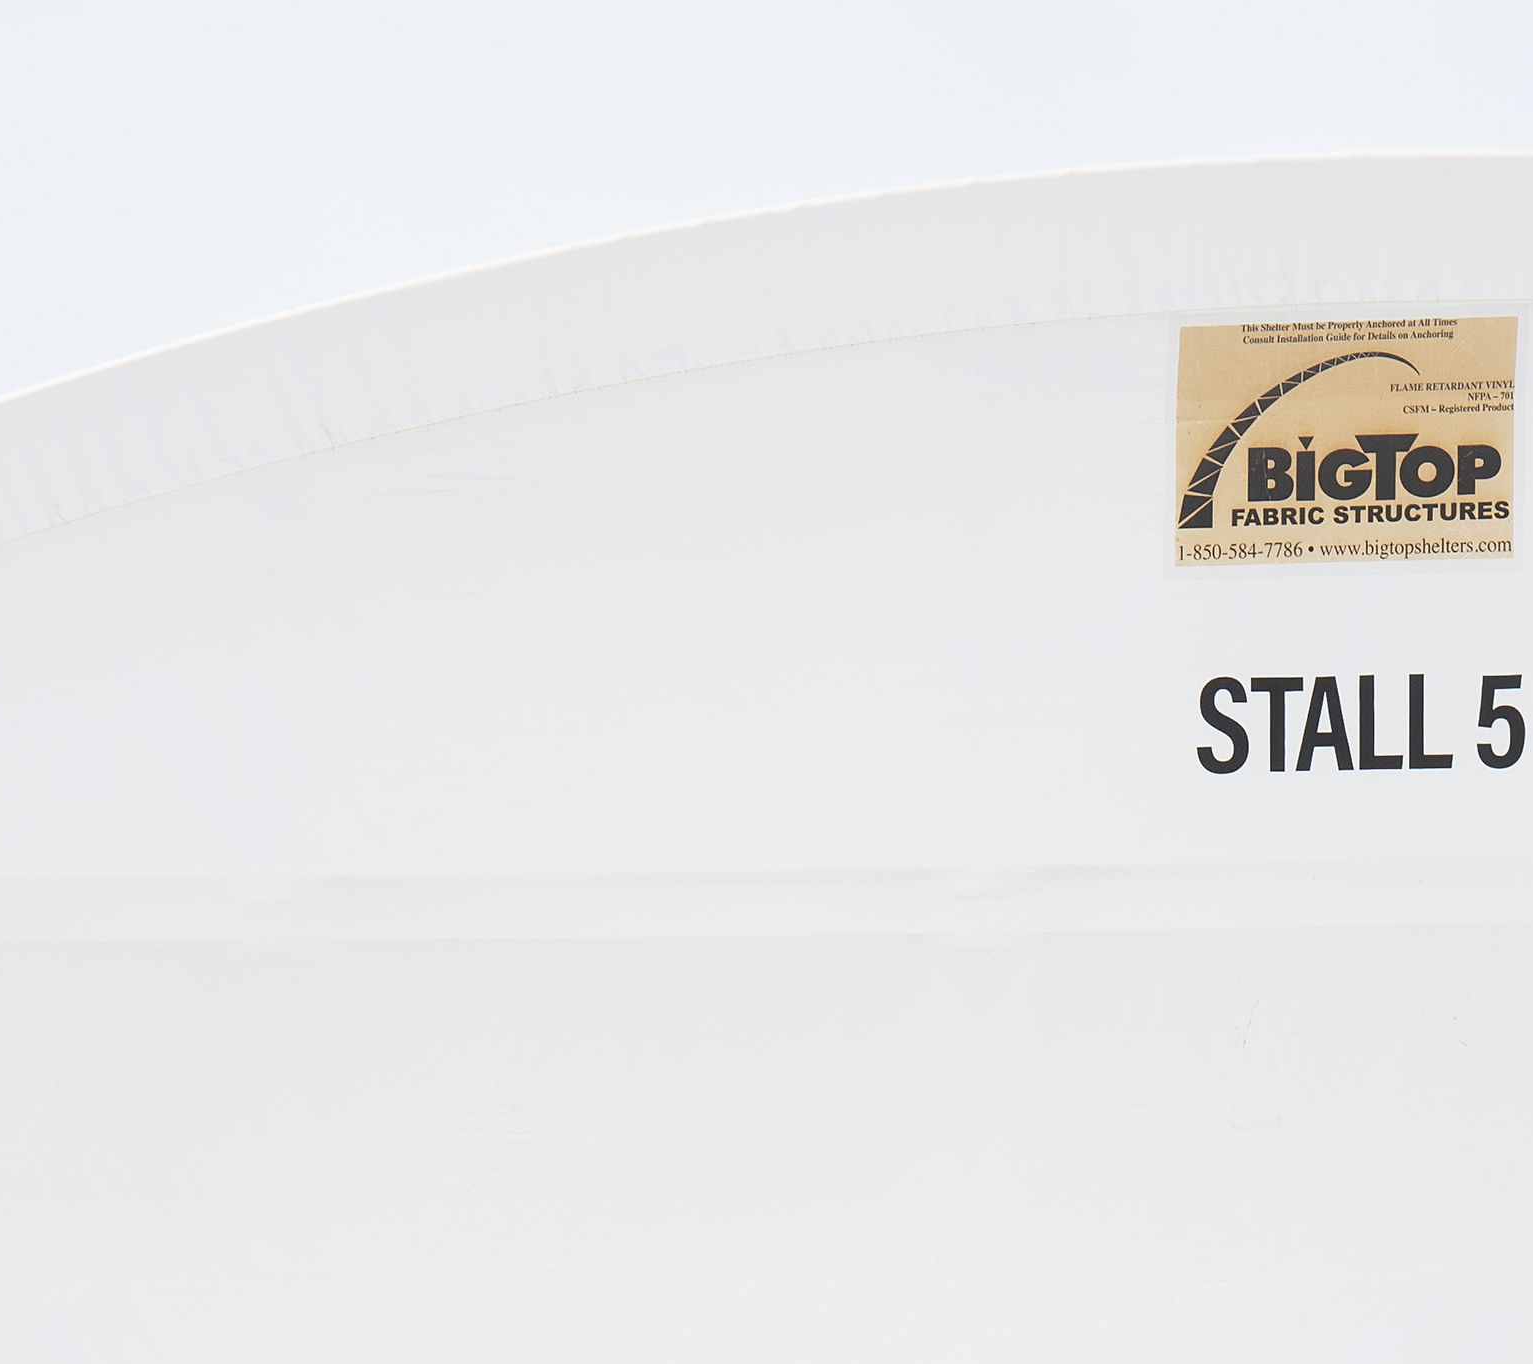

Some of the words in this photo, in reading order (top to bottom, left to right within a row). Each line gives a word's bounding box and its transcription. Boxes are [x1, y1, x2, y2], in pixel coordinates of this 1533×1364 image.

[1241, 324, 1258, 332] This
[1260, 323, 1290, 332] Shelter
[1292, 322, 1314, 331] Must
[1316, 321, 1326, 330] be
[1328, 321, 1363, 332] Properly
[1366, 319, 1406, 329] Anchored
[1418, 318, 1430, 327] All
[1432, 318, 1458, 327] Times
[1242, 335, 1274, 344] Consult
[1277, 334, 1324, 343] Installation
[1326, 333, 1351, 342] Guide
[1353, 332, 1366, 341] for
[1368, 331, 1396, 340] Details
[1410, 330, 1454, 340] Anchoring
[1390, 383, 1423, 392] FLAME
[1426, 381, 1484, 391] RETARDANT
[1485, 380, 1515, 390] VINYL
[1467, 392, 1491, 401] NFPA
[1500, 391, 1514, 400] 701
[1403, 405, 1429, 414] CSFM
[1438, 403, 1480, 415] Registered
[1482, 403, 1514, 412] Product
[1231, 506, 1325, 527] FABRIC
[1333, 500, 1510, 524] STRUCTURES
[1178, 541, 1303, 561] 1-850-584-7786
[1320, 538, 1512, 559] www.bigtopshelters.com
[1196, 674, 1454, 775] STALL
[1476, 674, 1526, 770] 5
